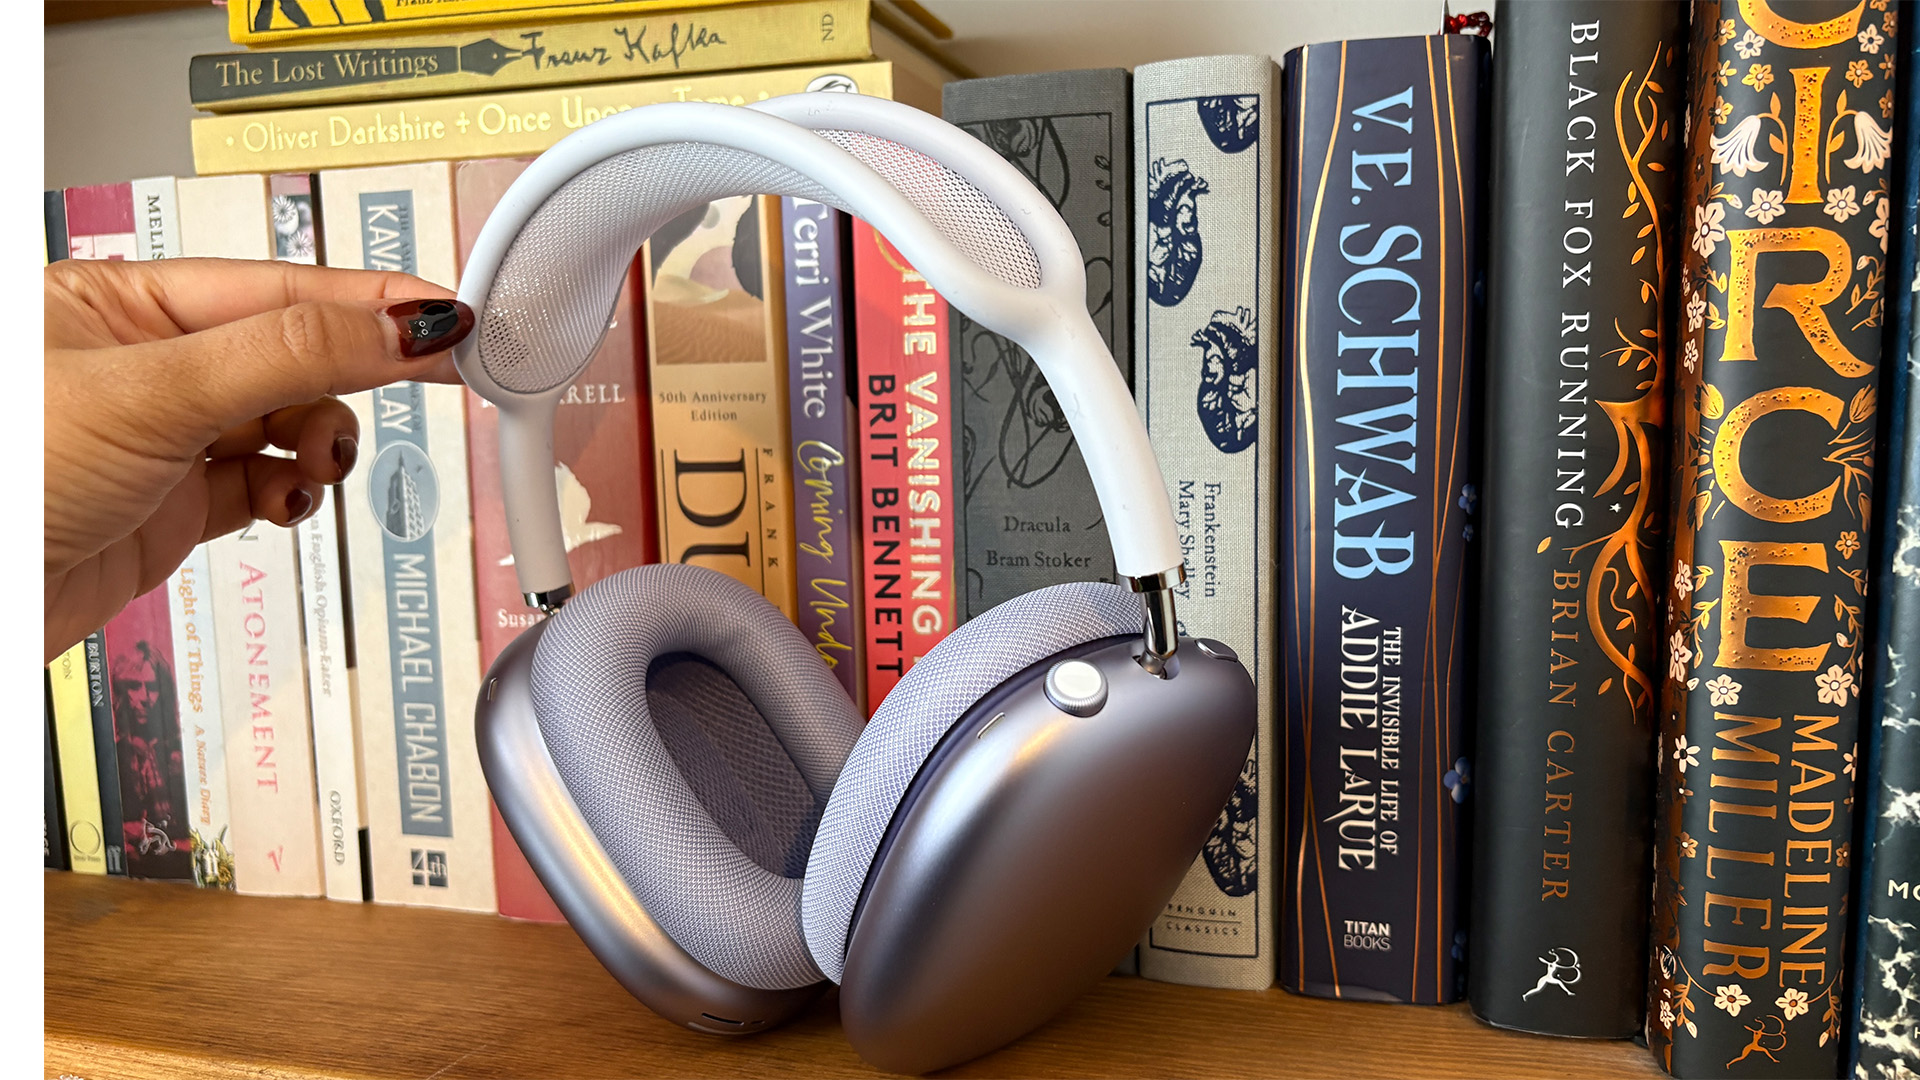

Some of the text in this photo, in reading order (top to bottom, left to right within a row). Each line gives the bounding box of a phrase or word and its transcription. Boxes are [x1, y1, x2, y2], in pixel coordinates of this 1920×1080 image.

[216, 50, 438, 87] The Lost Writings
[520, 22, 726, 70] Franz Kafka
[822, 13, 834, 42] ND
[242, 121, 318, 153] Oliver
[329, 111, 446, 147] Darkshire
[477, 102, 551, 136] Once
[561, 95, 633, 129] Upo
[792, 197, 834, 418] Terri White
[1554, 19, 1600, 529] BLACK FOX RUNNING
[1332, 85, 1423, 580] V. E. SCHWAB
[559, 383, 627, 405] RELL
[659, 390, 768, 404] 50th Anniversary
[690, 409, 738, 422] Edition
[902, 270, 943, 635] THE VANISHING
[762, 448, 779, 568] FRANK
[797, 440, 845, 564] Coming
[867, 375, 903, 677] BRIT BENNETT
[1003, 515, 1071, 533] Dracula
[1175, 480, 1195, 530] Mary
[1204, 481, 1222, 598] Frankenstein
[309, 532, 327, 593] English
[985, 549, 1093, 568] Bram Stoker
[179, 567, 204, 713] Light of Things
[239, 560, 279, 795] ATONEMENT
[393, 553, 444, 823] MICHAEL CHABON
[1323, 605, 1380, 871] ADDIE LARUE
[1380, 626, 1401, 855] THE INVISIBLE LIFE OF
[1541, 569, 1581, 902] BRIAN CARTER
[330, 790, 346, 866] OXFORD
[1702, 711, 1782, 980] MILLER
[1779, 714, 1840, 988] MADELINE
[1166, 921, 1239, 936] CLASSICS
[1167, 903, 1236, 917] PENGUIN
[1344, 920, 1391, 937] TITAN
[1344, 934, 1391, 951] BOOKS
